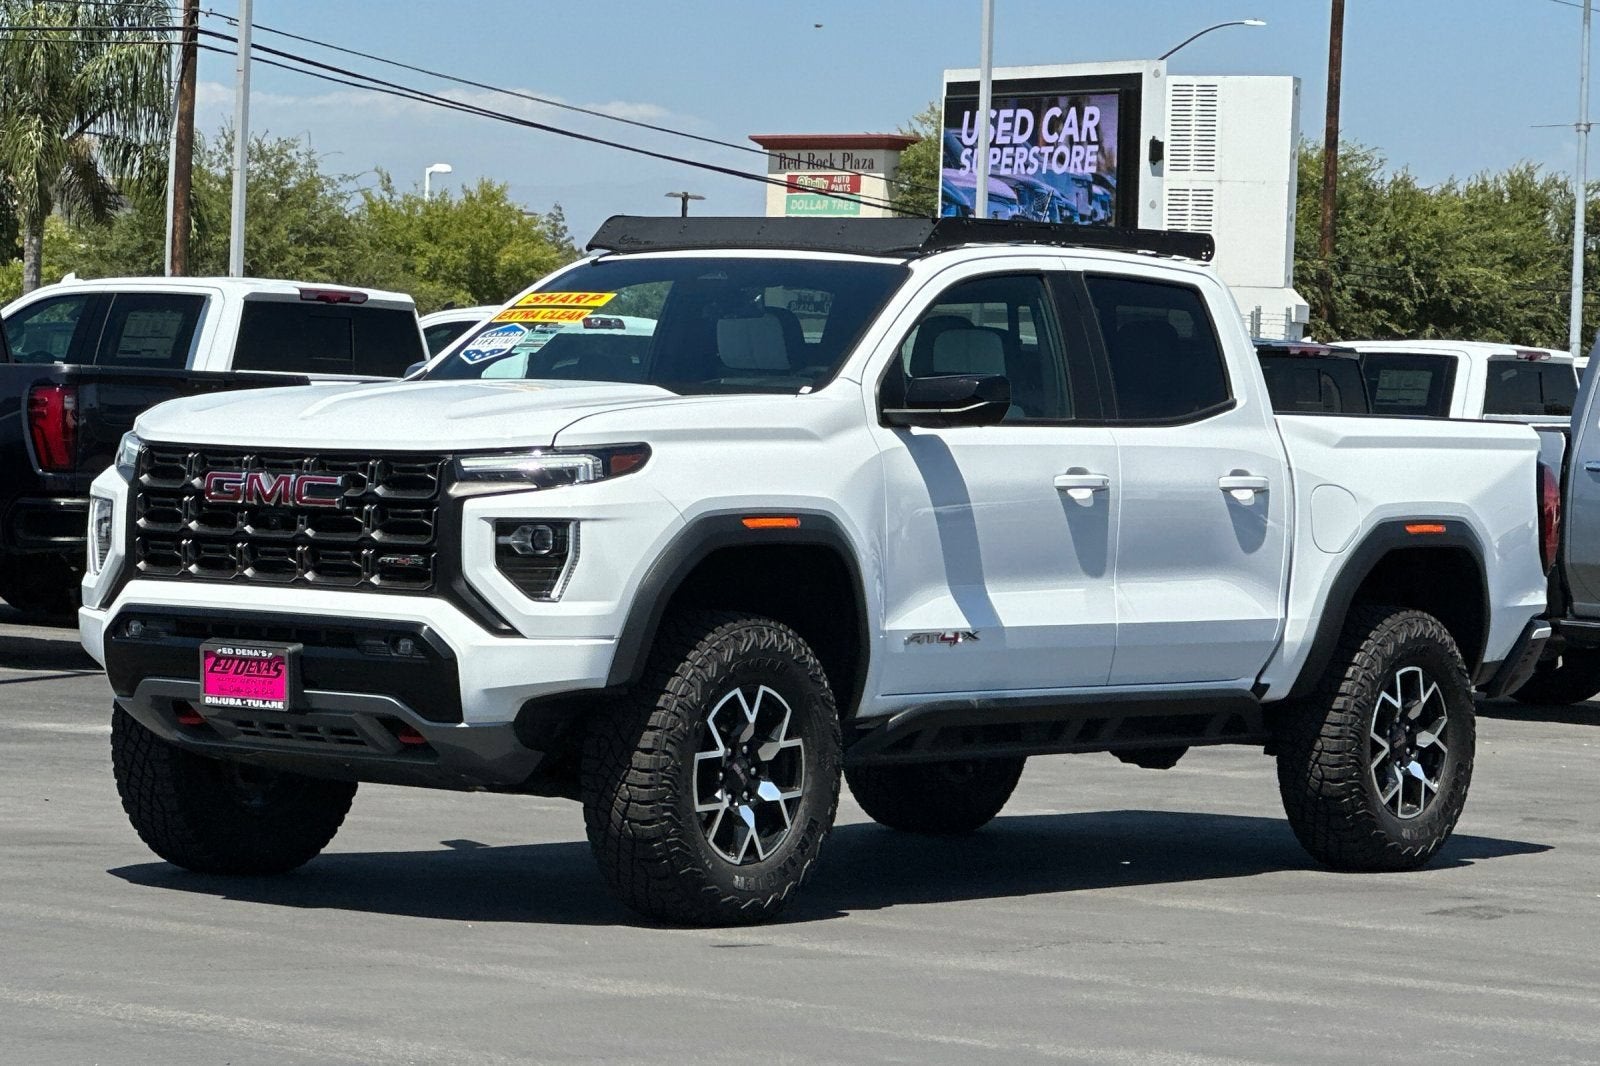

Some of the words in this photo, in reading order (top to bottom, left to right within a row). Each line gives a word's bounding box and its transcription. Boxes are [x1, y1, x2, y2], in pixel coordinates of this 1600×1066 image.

[1042, 106, 1101, 143] CAR
[778, 152, 800, 170] Red
[807, 152, 835, 170] Rock
[842, 152, 874, 170] Plaza
[833, 175, 850, 184] AUTO
[830, 184, 851, 192] PARTS
[791, 199, 827, 210] DOLLAR
[832, 200, 855, 210] TREE
[527, 294, 605, 304] SHARP
[499, 310, 539, 320] EXTRA
[541, 311, 587, 320] CLEAN
[204, 471, 344, 508] GMC
[222, 647, 234, 655] ED
[235, 648, 268, 657] DENA'S
[246, 699, 284, 709] TULARE
